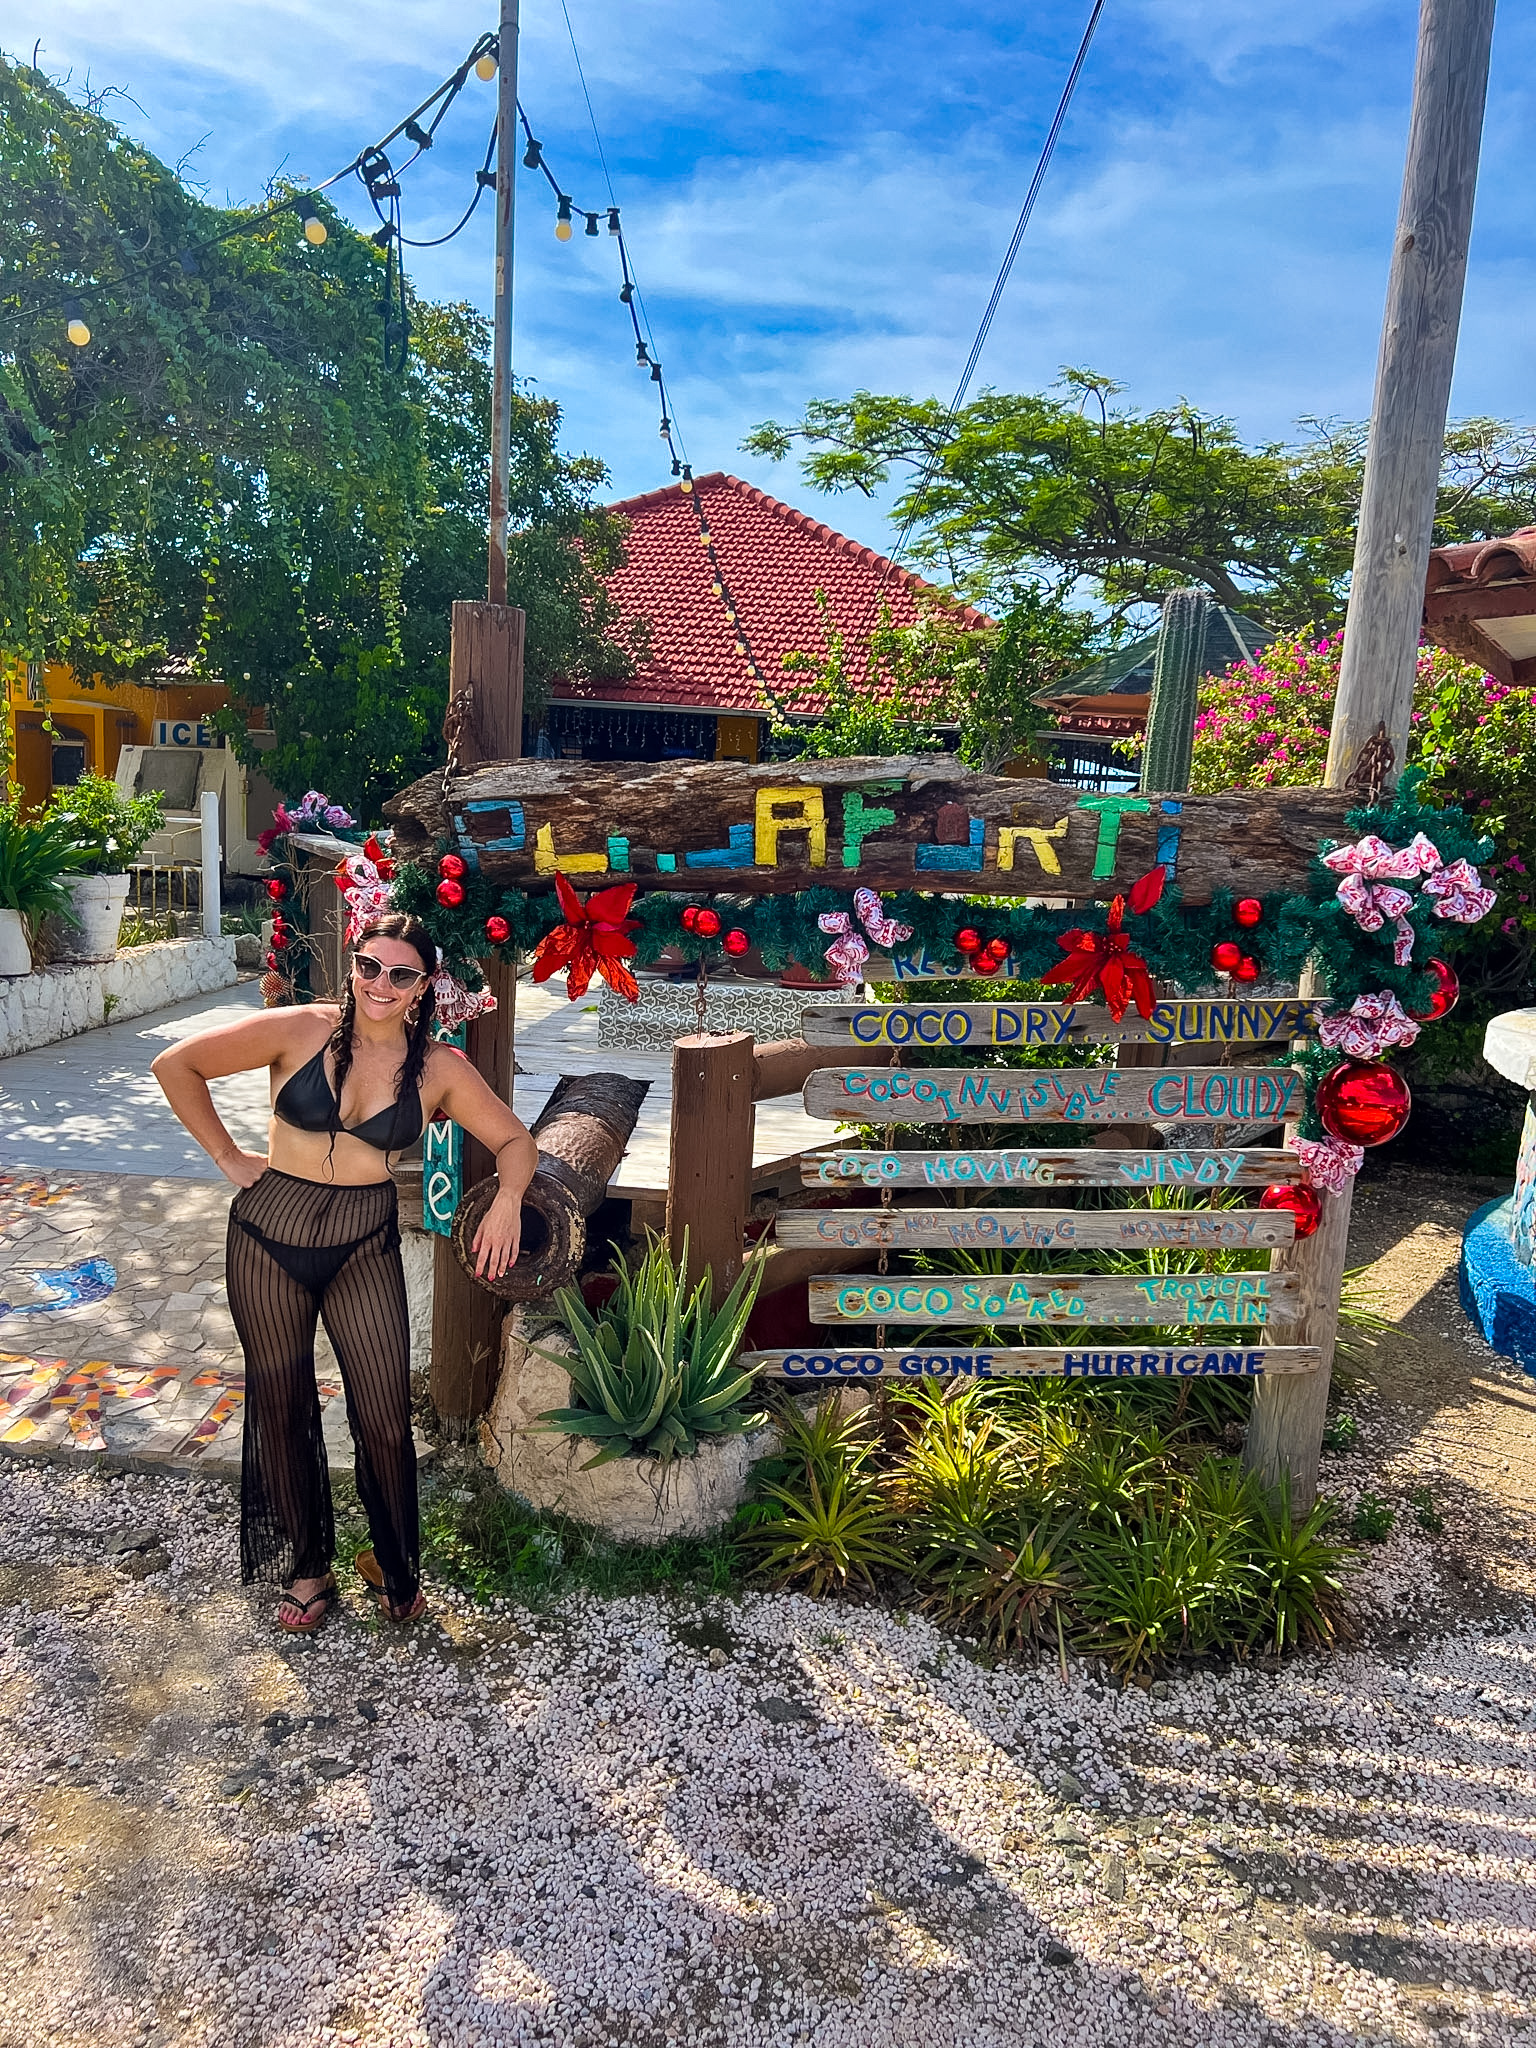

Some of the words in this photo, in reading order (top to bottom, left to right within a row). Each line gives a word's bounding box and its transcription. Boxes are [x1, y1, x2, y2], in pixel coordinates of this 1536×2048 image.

[160, 723, 211, 746] ICE
[850, 1010, 972, 1046] COCO
[992, 1007, 1076, 1045] DRY
[1145, 1002, 1287, 1042] SUNNY
[842, 1071, 938, 1102] COCO
[1148, 1074, 1298, 1122] CLOUDY
[819, 1156, 900, 1186] COCO
[817, 1216, 899, 1246] COCO
[836, 1286, 952, 1319] COCO
[962, 1282, 1085, 1320] SOAKED
[782, 1354, 884, 1376] COCO
[899, 1354, 994, 1376] GONE
